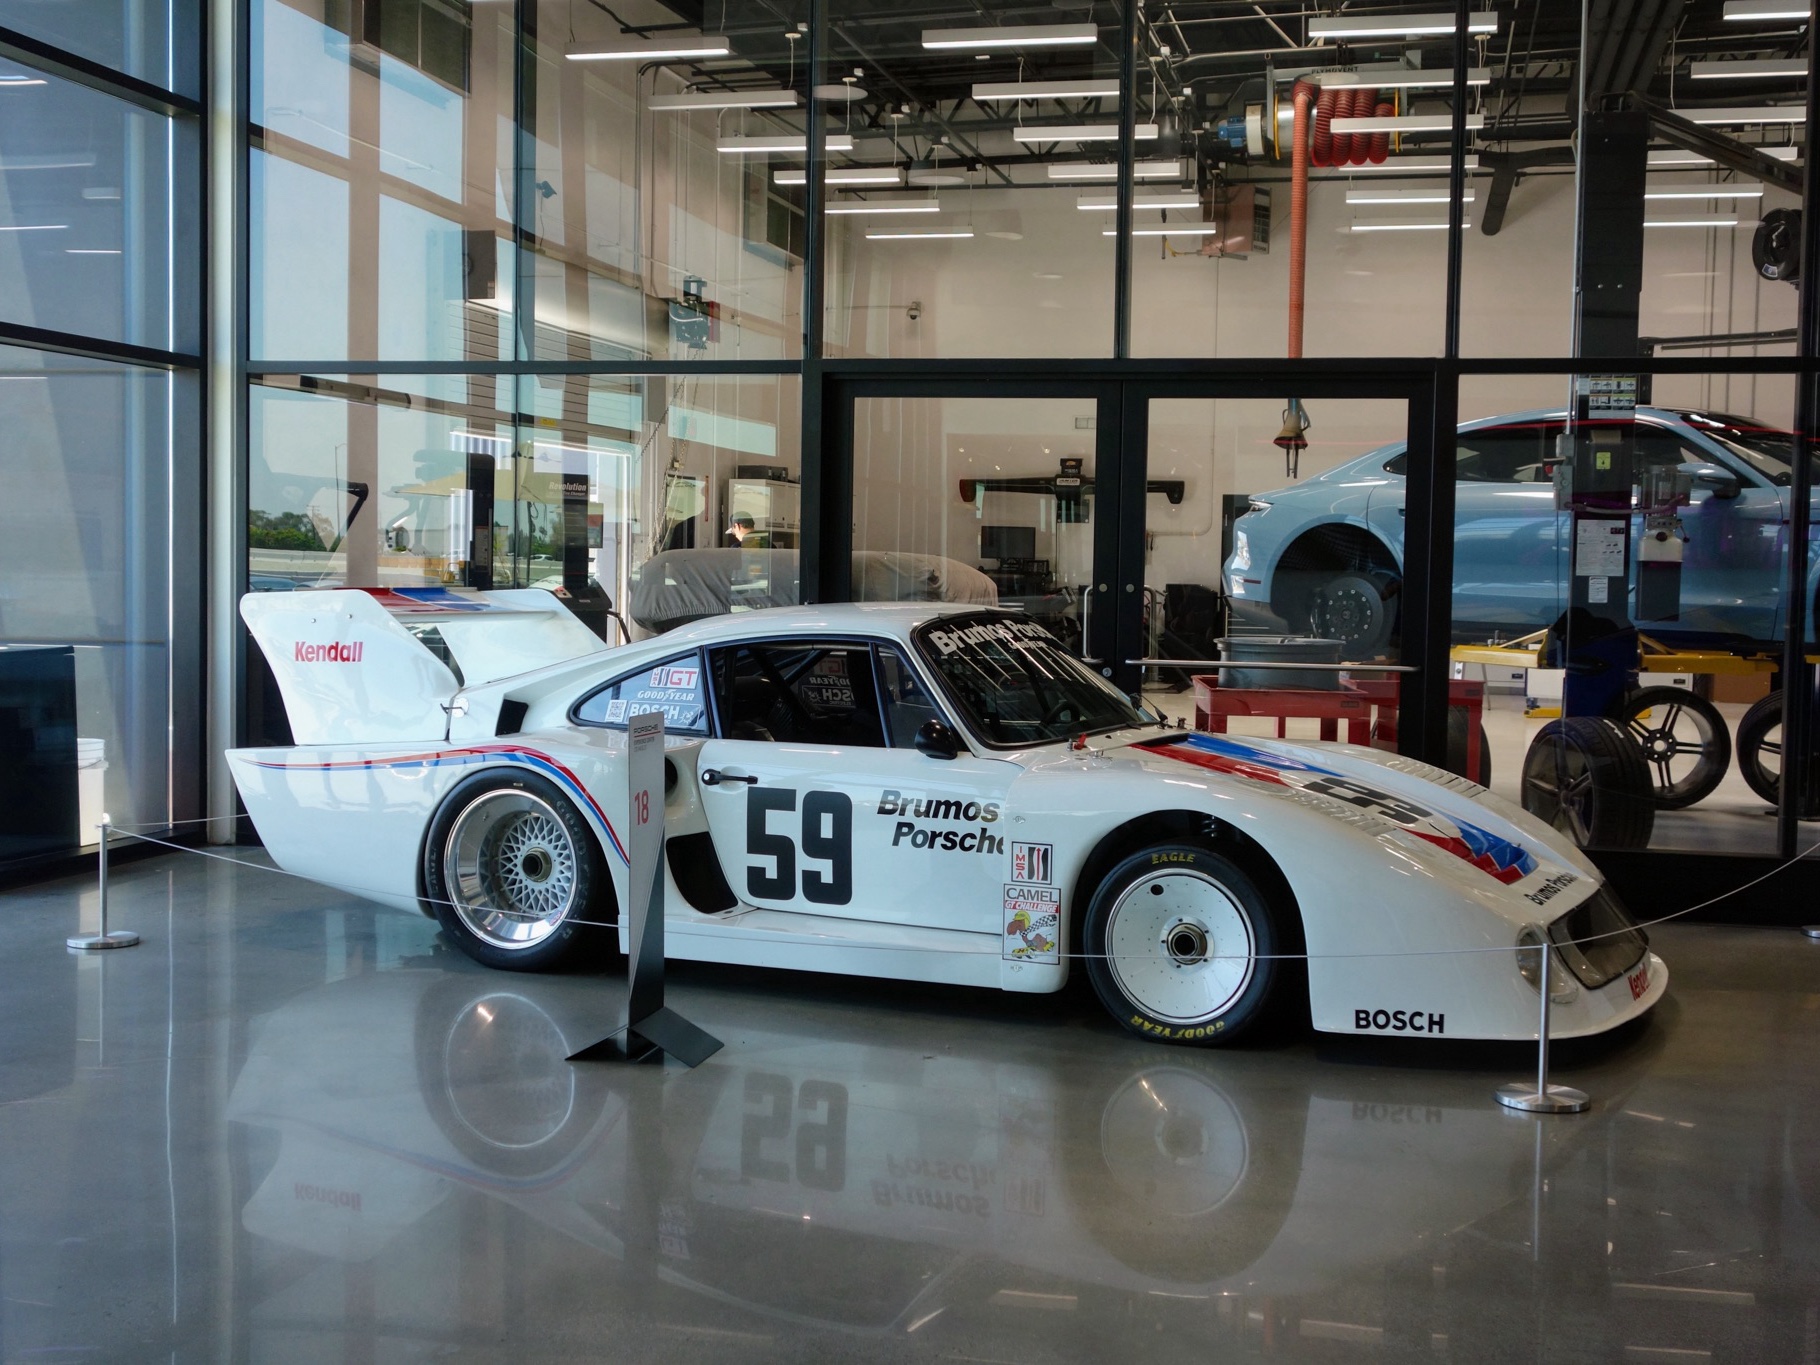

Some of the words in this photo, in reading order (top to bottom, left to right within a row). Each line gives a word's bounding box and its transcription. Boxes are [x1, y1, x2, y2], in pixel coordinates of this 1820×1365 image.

[1311, 66, 1359, 74] PLYMOVENT
[548, 481, 587, 491] Revolution
[928, 622, 1014, 655] Brumos
[294, 641, 364, 662] Kendall
[669, 670, 697, 686] GT
[637, 689, 695, 701] GOODYEAR
[634, 789, 649, 826] 18
[877, 789, 1001, 823] Brumos
[746, 786, 853, 905] 59
[1015, 845, 1026, 880] IMSA
[1151, 852, 1196, 865] EAGLE
[1006, 887, 1058, 903] CAMEL
[1005, 900, 1016, 910] GT
[1015, 902, 1058, 913] CHALLENGE
[1129, 1014, 1226, 1040] GOODYEAR
[1354, 1009, 1445, 1034] BOSCH
